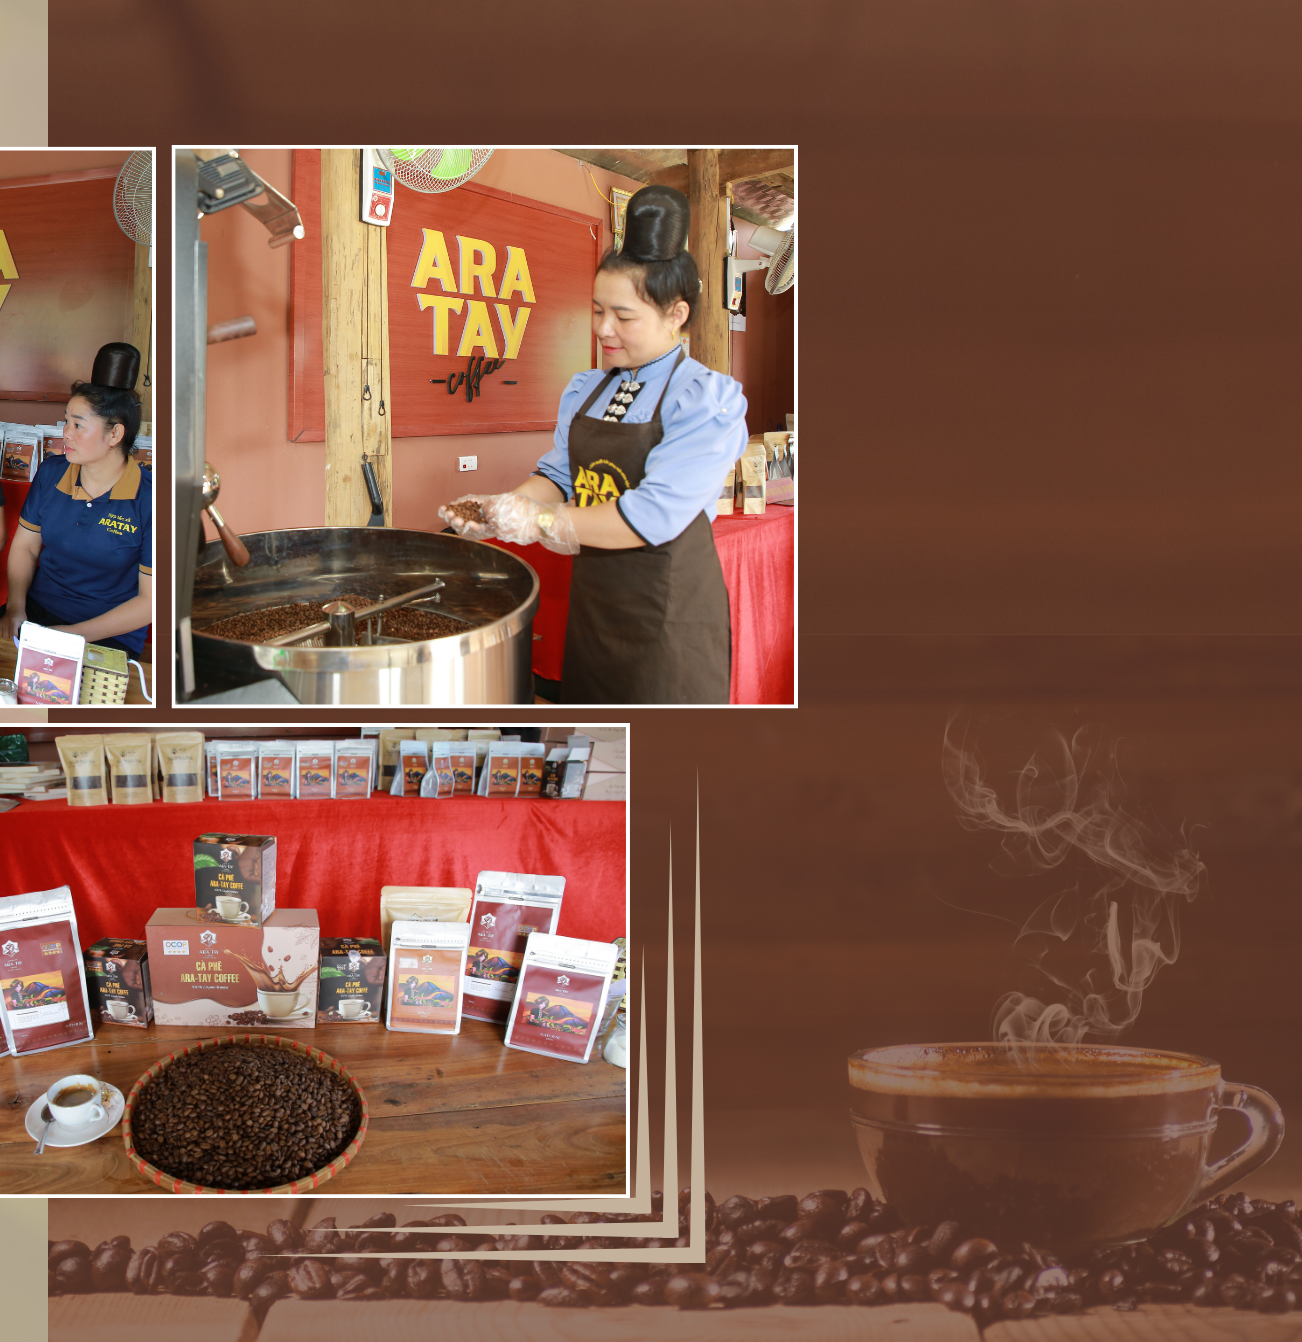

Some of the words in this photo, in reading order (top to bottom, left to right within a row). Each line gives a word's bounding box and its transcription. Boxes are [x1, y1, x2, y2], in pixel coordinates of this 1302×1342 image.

[410, 227, 536, 303] ARA
[416, 293, 532, 359] TAY
[446, 355, 506, 403] coffee
[574, 465, 621, 497] ARA
[98, 517, 138, 534] ARATAY
[180, 973, 212, 983] ARA-TAY
[213, 973, 240, 983] COFFEE
[195, 959, 207, 972] CÀ
[208, 960, 223, 972] PHÊ
